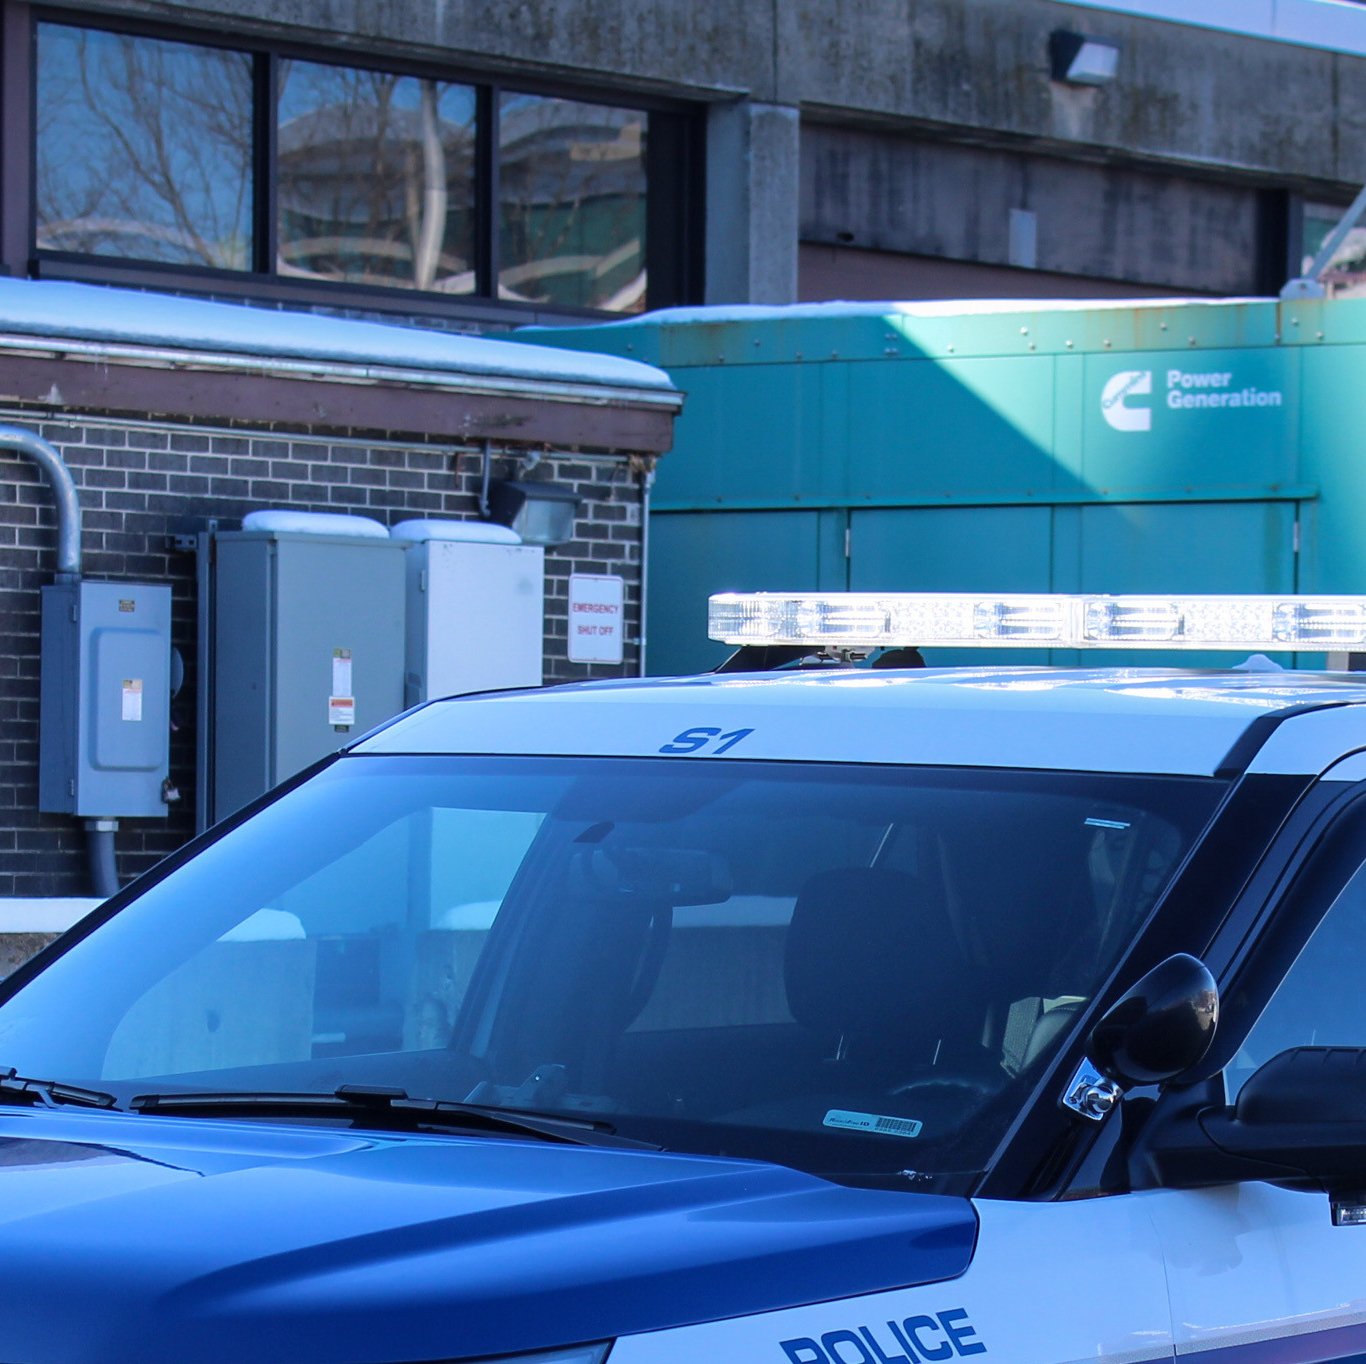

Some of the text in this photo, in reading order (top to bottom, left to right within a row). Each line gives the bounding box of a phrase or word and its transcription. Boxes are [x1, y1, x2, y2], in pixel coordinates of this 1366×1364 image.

[1167, 370, 1232, 388] Power
[1167, 388, 1282, 409] Generation
[572, 603, 618, 614] EMERGENCY
[577, 625, 614, 636] SHUT OFF
[659, 727, 755, 754] S1
